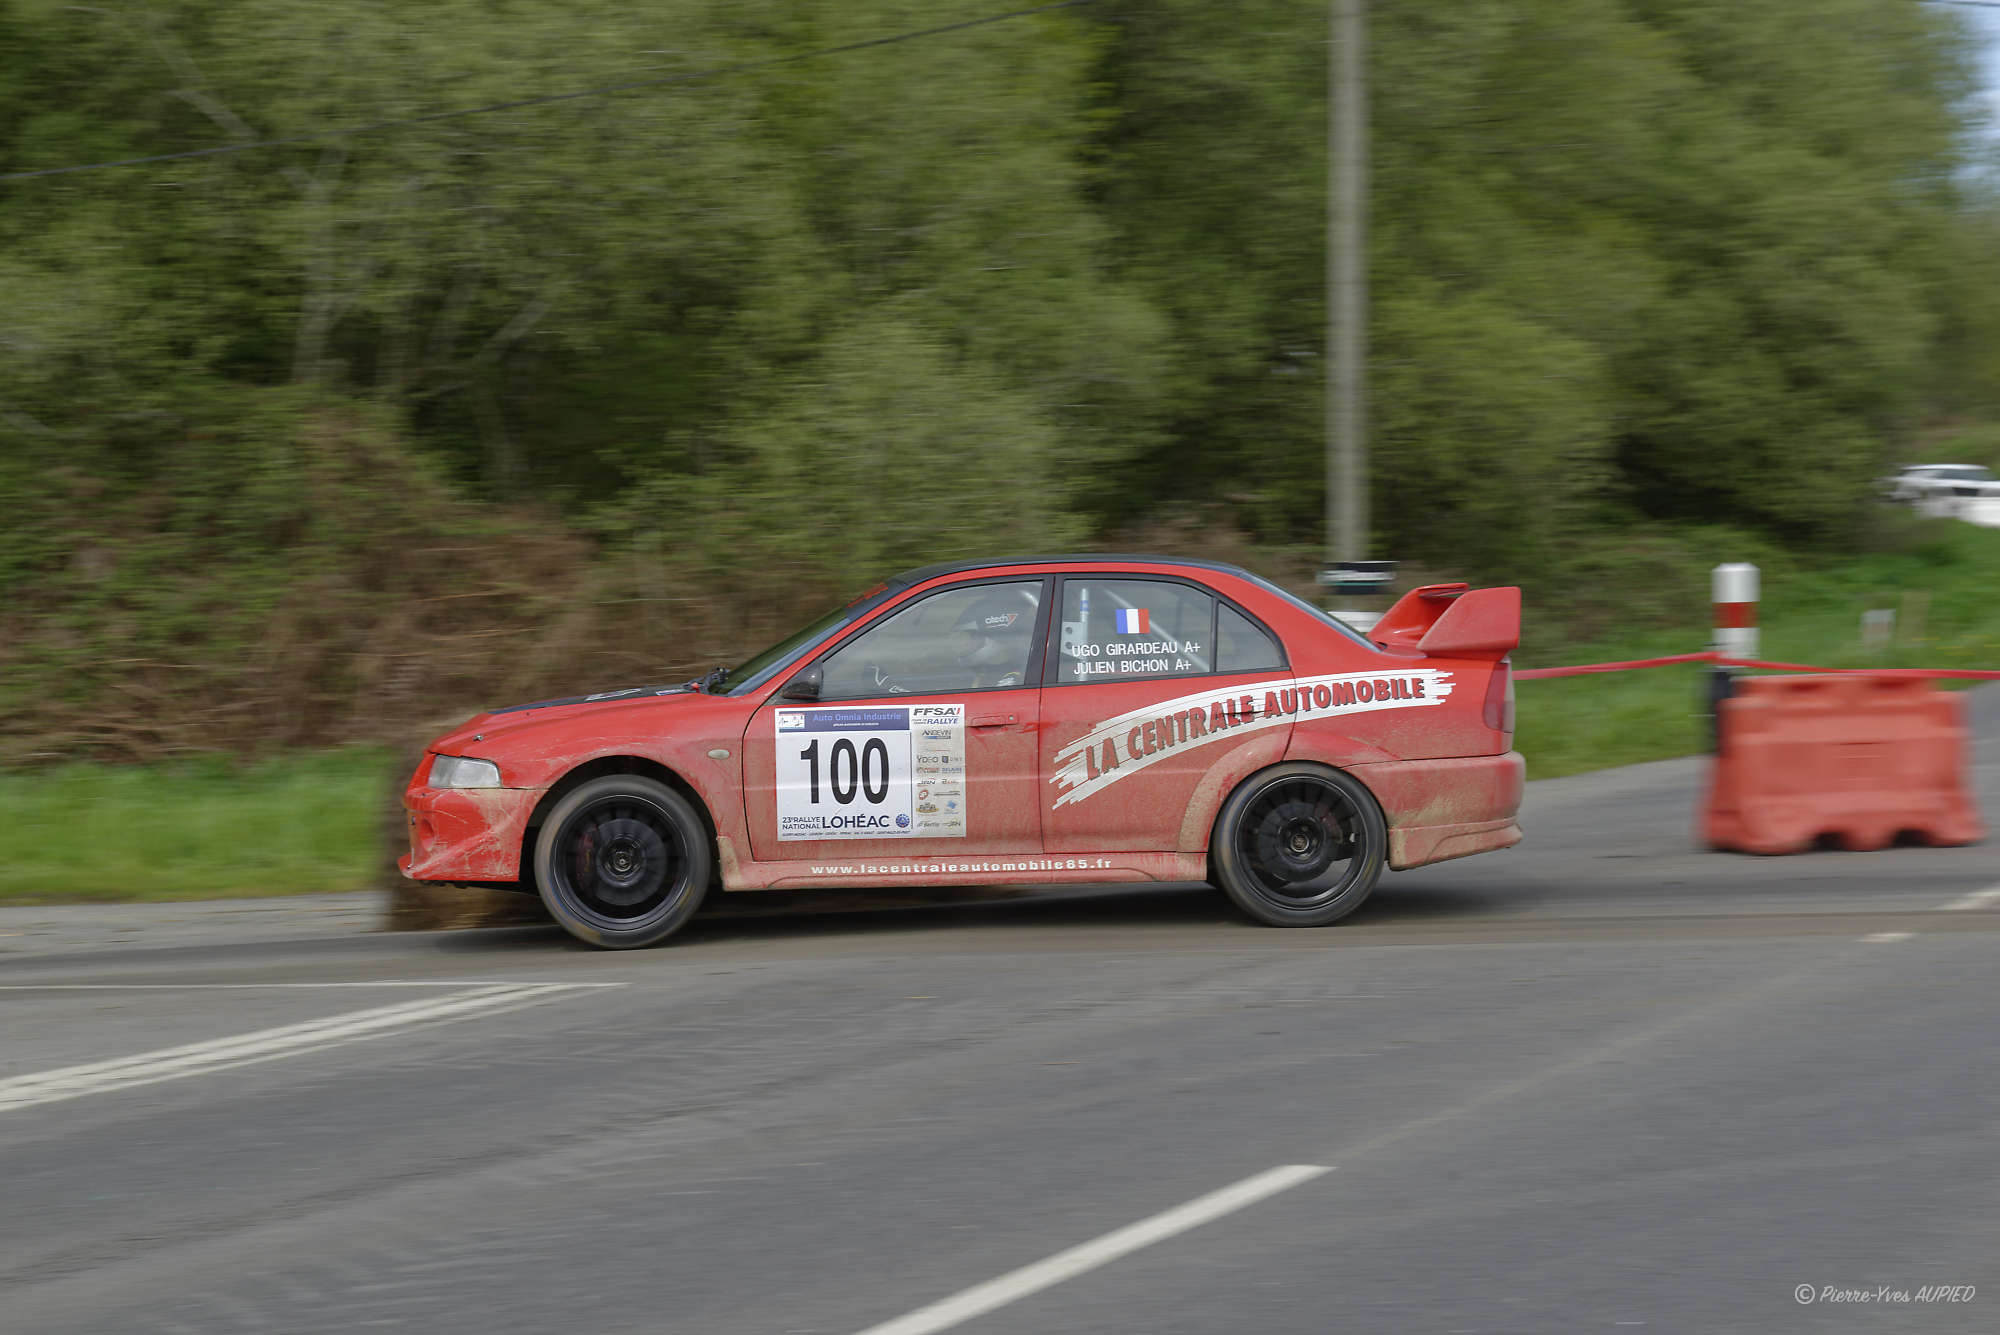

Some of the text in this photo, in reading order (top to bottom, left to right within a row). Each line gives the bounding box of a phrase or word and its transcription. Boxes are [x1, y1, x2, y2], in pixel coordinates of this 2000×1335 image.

[1071, 641, 1201, 657] UGO GIRARDEAU A+
[1073, 658, 1192, 674] JULIEN BICHON A+
[813, 713, 833, 722] Auto
[913, 707, 956, 716] FFSA
[927, 717, 959, 725] RALLYE
[1084, 677, 1426, 781] LA CENTRALE AUTOMOBILE
[800, 737, 890, 805] 100
[821, 813, 890, 829] LOHÉAC
[811, 858, 1112, 875] www.lacentraleautomobile85.fr
